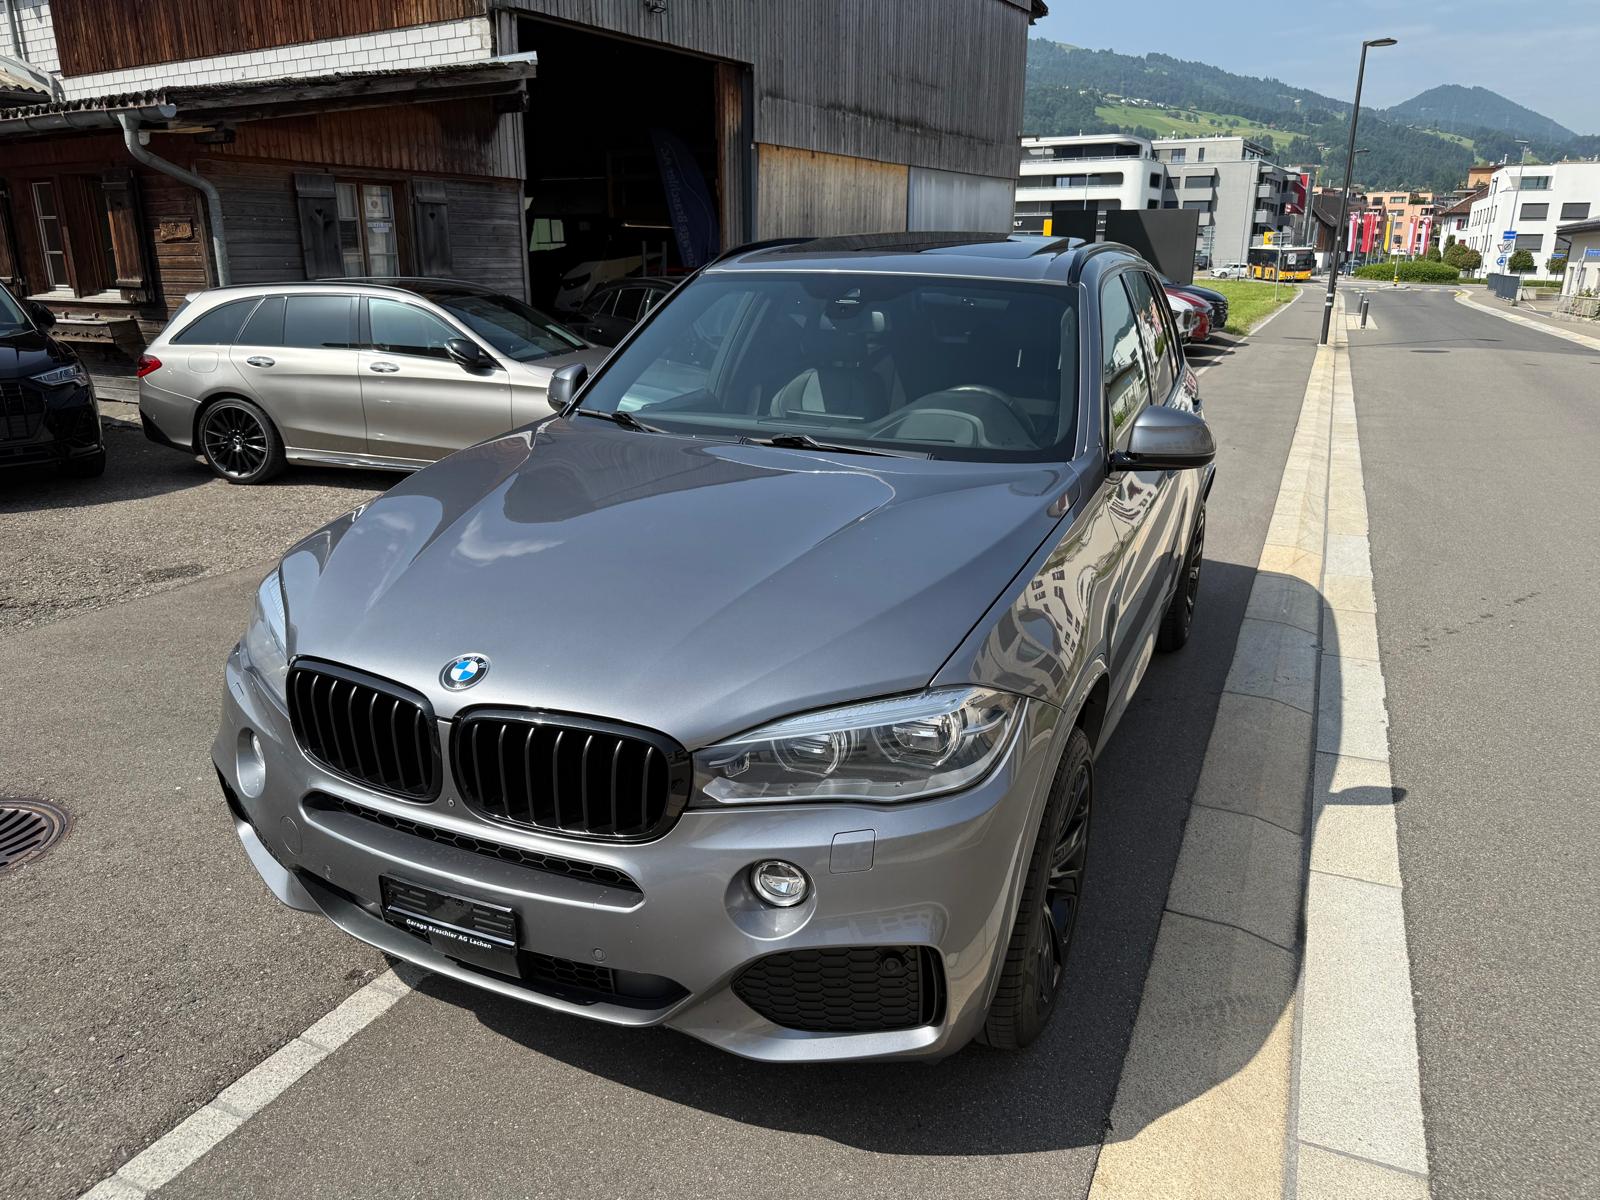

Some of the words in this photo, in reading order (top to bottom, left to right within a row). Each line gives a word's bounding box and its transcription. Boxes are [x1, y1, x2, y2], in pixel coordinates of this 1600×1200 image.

[406, 919, 427, 930] Garage
[428, 925, 457, 938] Braschler
[458, 935, 468, 943] AG
[469, 938, 492, 949] Lachen
